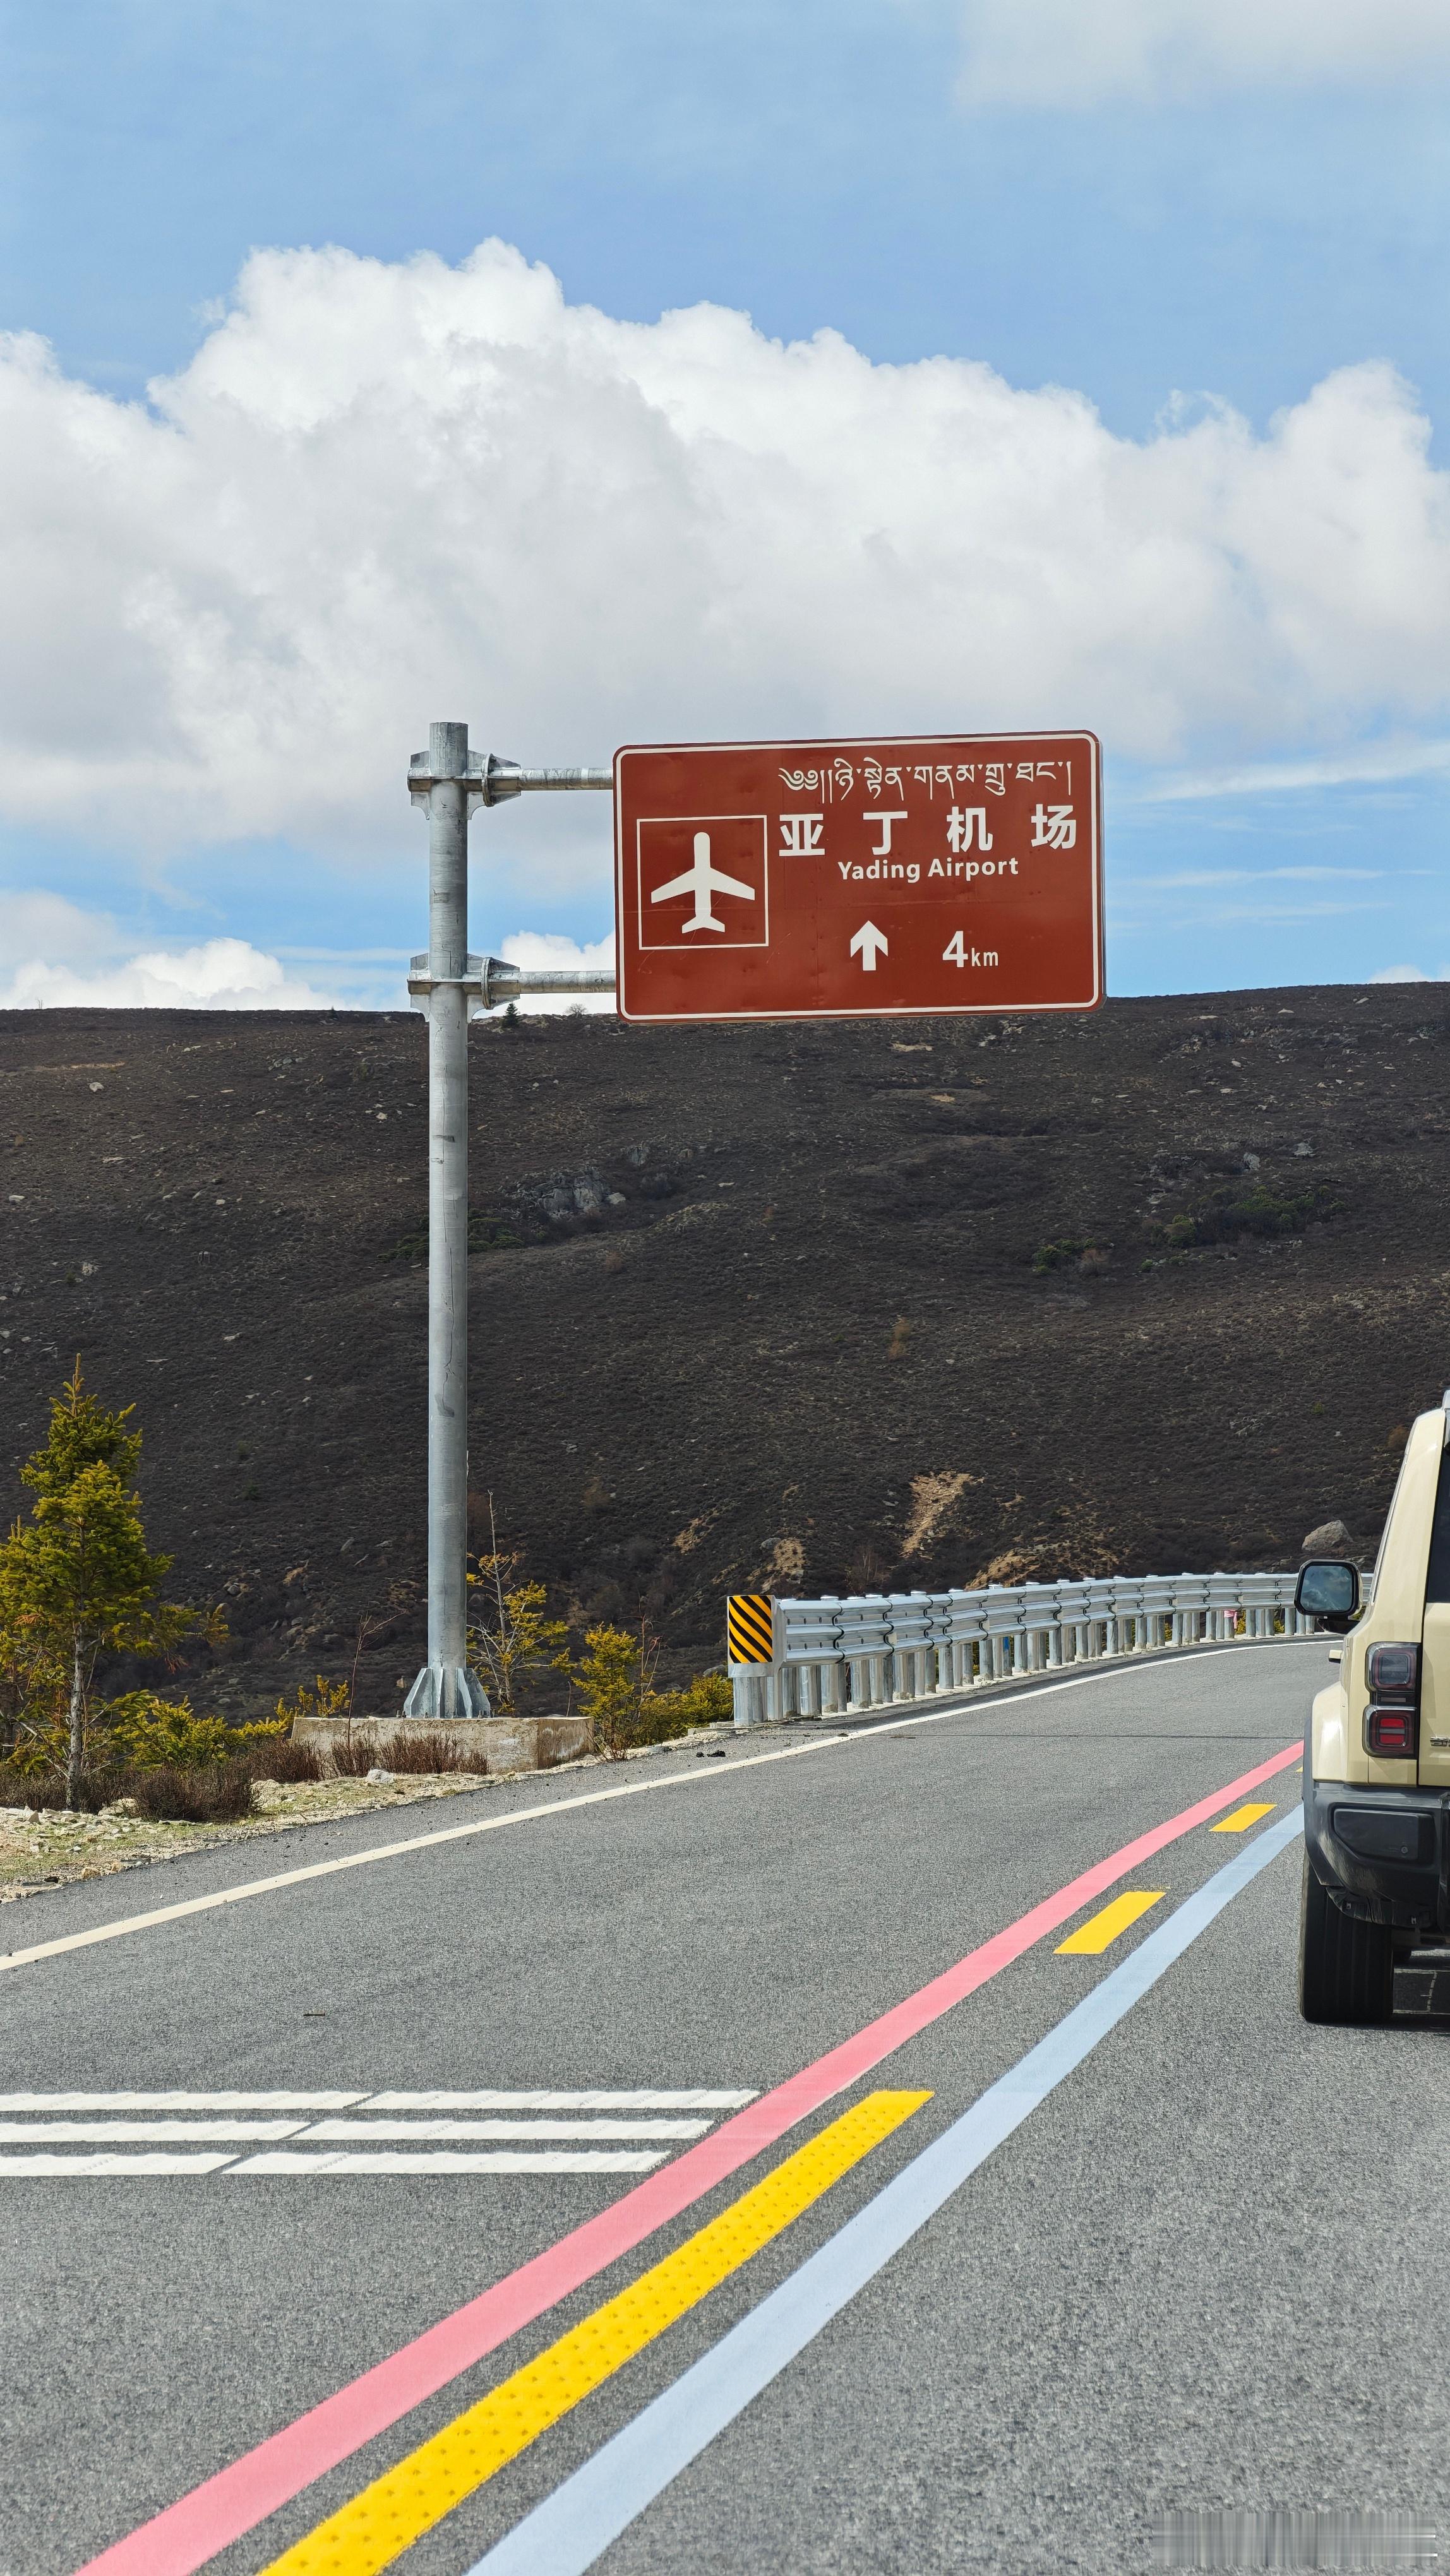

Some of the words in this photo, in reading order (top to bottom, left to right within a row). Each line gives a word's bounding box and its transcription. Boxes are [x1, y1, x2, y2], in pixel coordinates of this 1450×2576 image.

[779, 804, 1077, 857] 亚丁机场
[838, 859, 920, 883] Yading
[928, 857, 1019, 882] Airport
